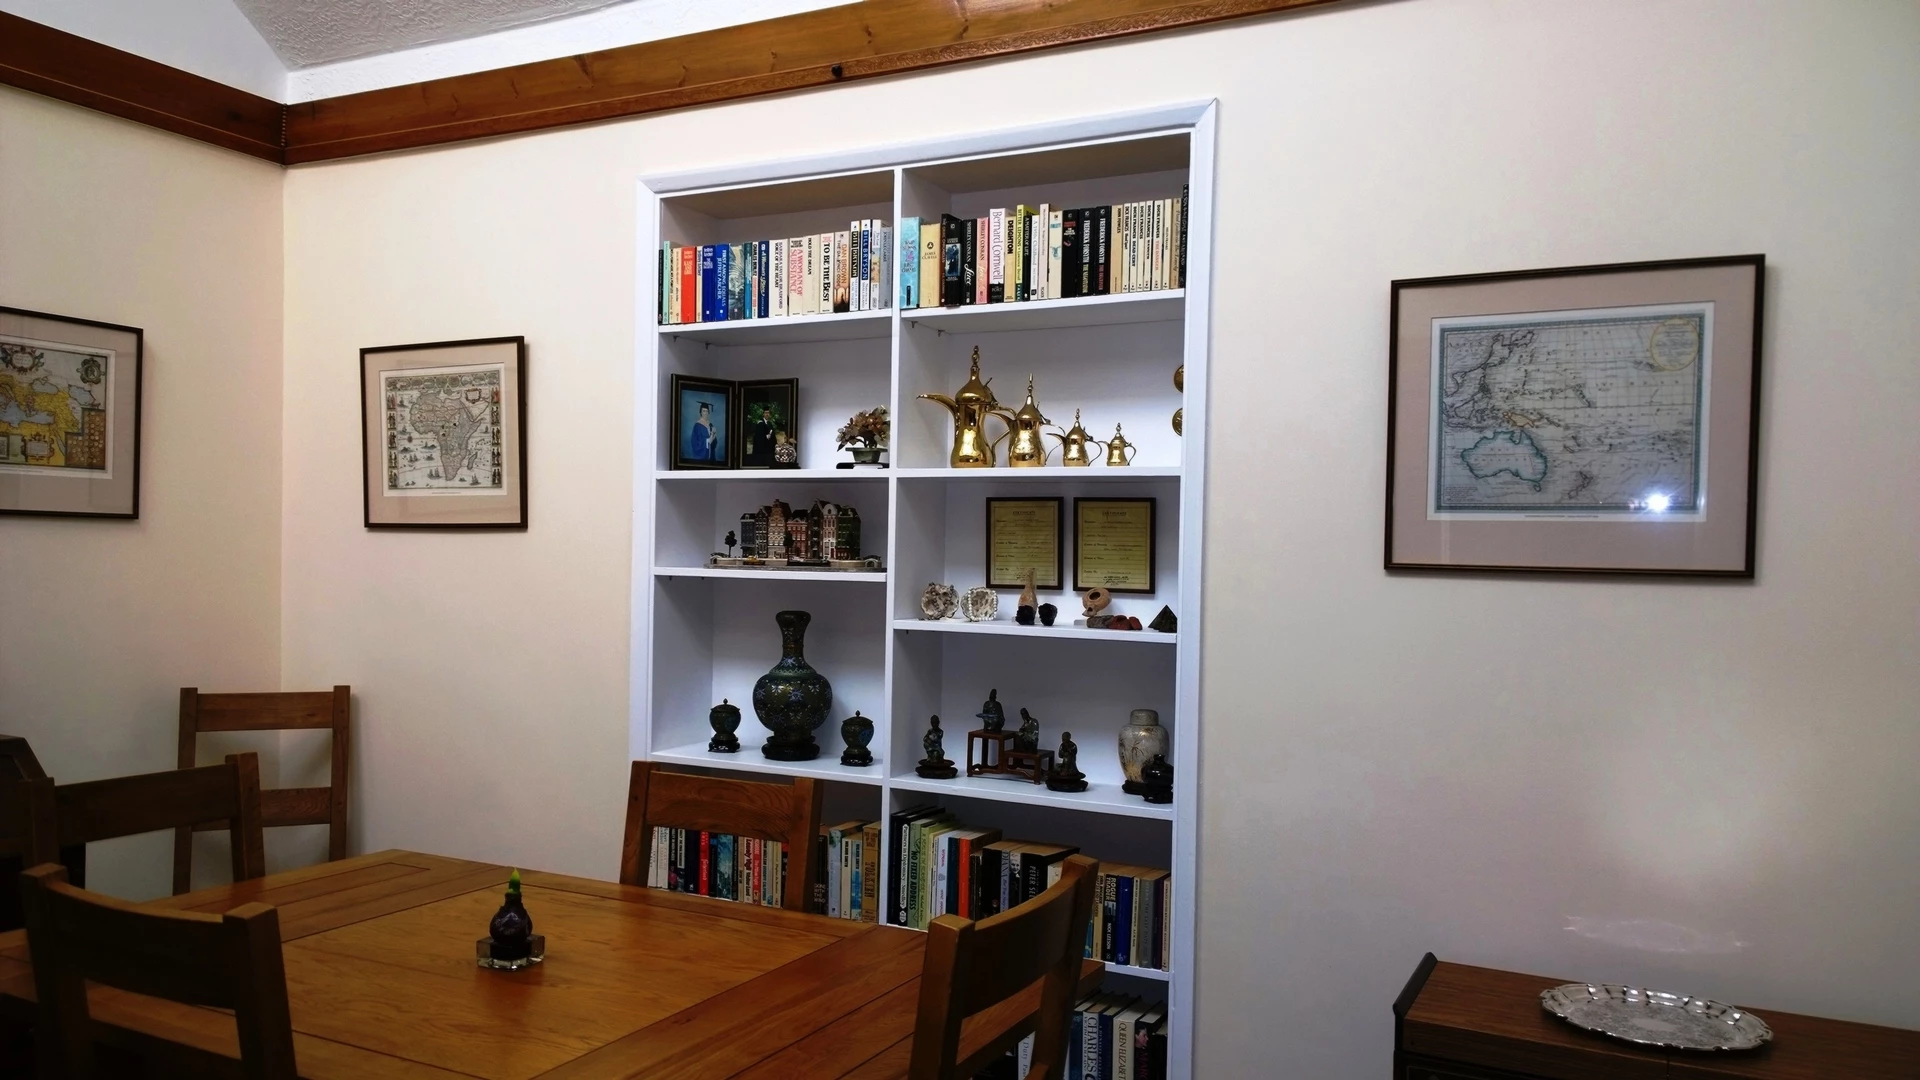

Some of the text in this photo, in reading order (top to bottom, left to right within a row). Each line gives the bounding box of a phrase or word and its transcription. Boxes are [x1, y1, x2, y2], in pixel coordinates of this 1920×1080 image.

[823, 243, 830, 254] TO
[992, 211, 1003, 280] Bernard Cornwell
[823, 255, 830, 265] BE
[797, 287, 803, 296] OF
[822, 282, 831, 302] BEST
[911, 851, 918, 860] NO
[1118, 1022, 1126, 1047] QUEEN
[1021, 1042, 1029, 1060] Duty
[1087, 1017, 1098, 1073] CHARLES
